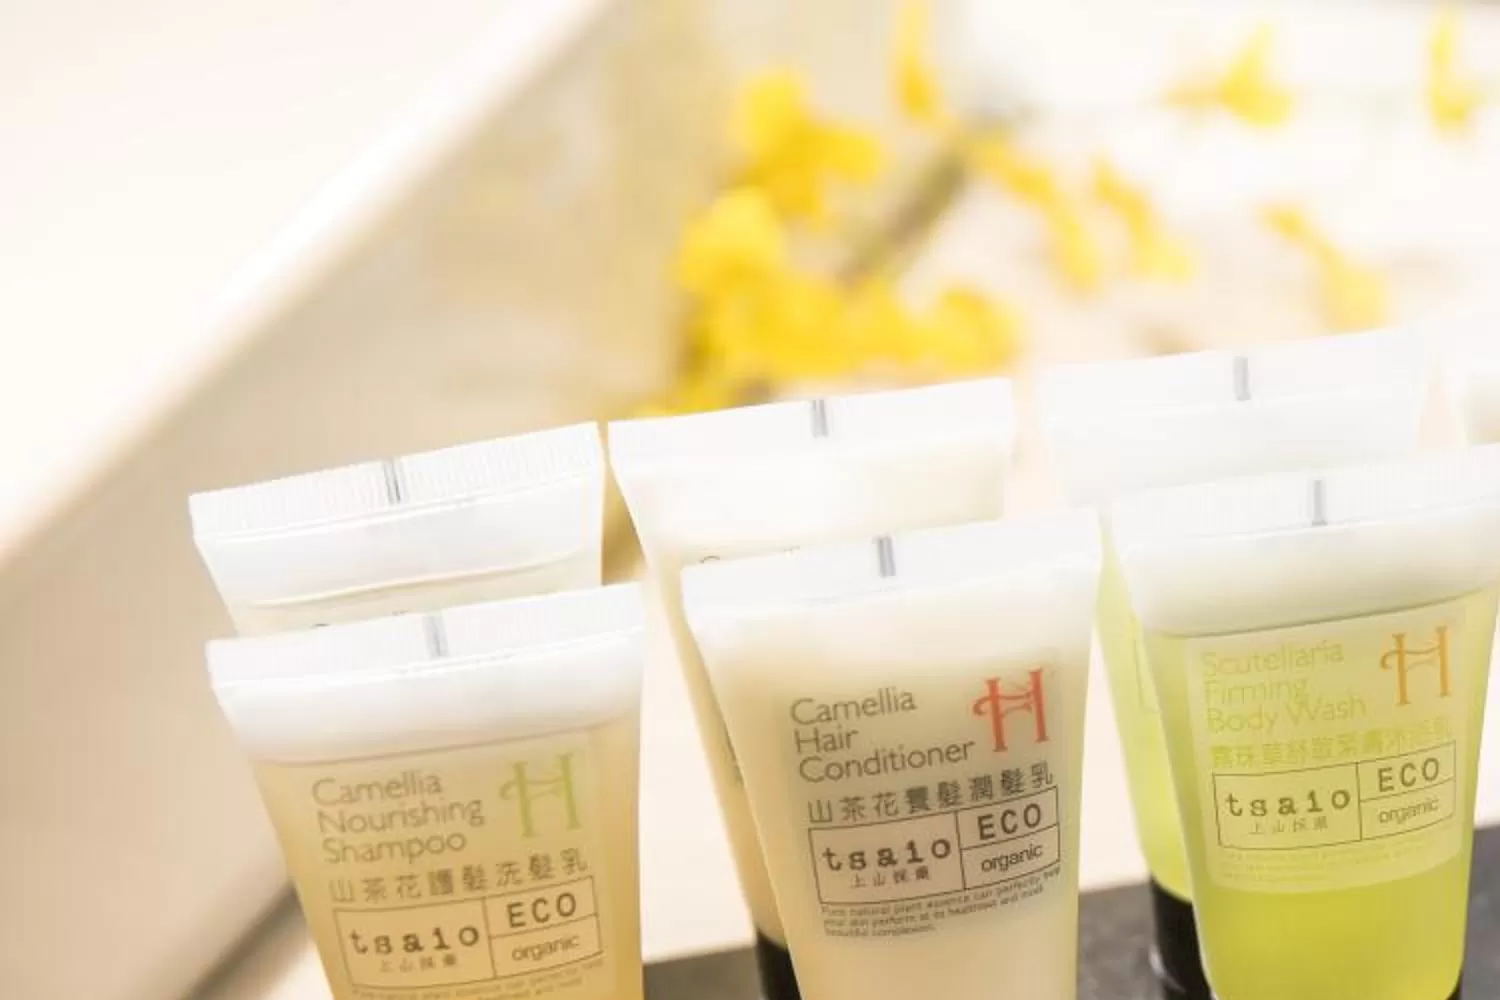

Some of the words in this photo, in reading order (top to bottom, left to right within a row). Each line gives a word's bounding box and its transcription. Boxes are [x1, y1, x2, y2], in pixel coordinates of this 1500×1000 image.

[1202, 640, 1345, 678] Scutellaria
[790, 686, 917, 725] Camellia
[1204, 676, 1308, 707] Firming
[1207, 702, 1279, 735] Body
[1284, 693, 1368, 727] Wash
[794, 724, 859, 754] Hair
[799, 739, 976, 783] Conditioner
[1377, 757, 1440, 792] ECO
[311, 771, 443, 808] Camellia
[318, 799, 486, 835] Nourishing
[977, 803, 1042, 841] ECO
[1378, 797, 1440, 825] organic
[323, 831, 468, 865] Shampoo
[981, 843, 1043, 874] organic
[506, 891, 577, 929] ECO
[511, 935, 582, 962] organic
